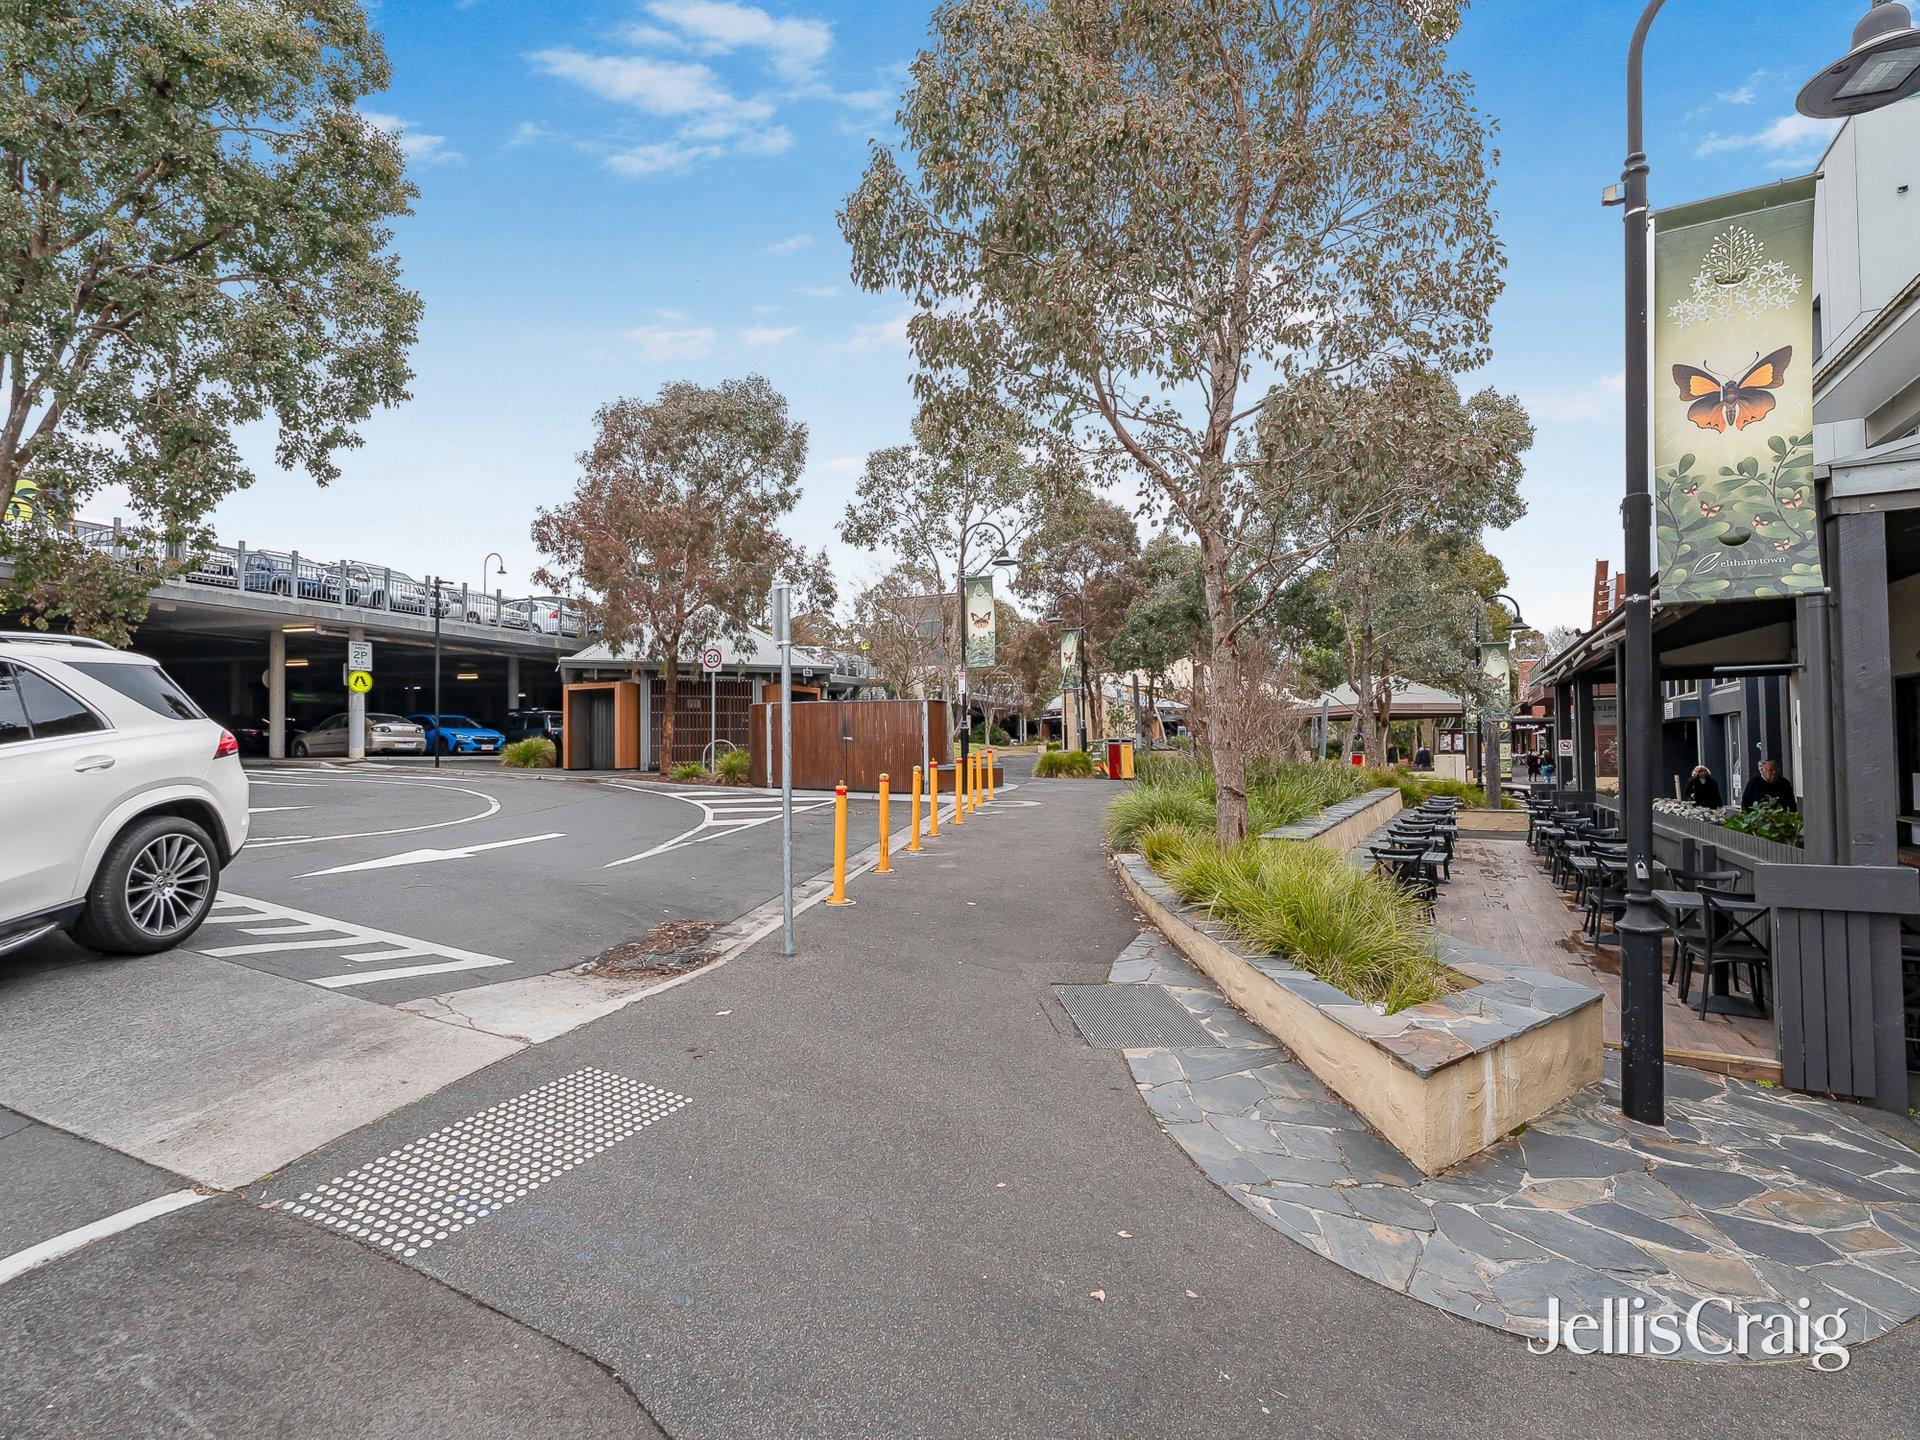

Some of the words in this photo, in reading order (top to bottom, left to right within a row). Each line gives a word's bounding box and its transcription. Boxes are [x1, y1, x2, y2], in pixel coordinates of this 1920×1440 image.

[1720, 559, 1757, 567] eltham
[353, 650, 368, 659] 2P
[707, 654, 719, 663] 20
